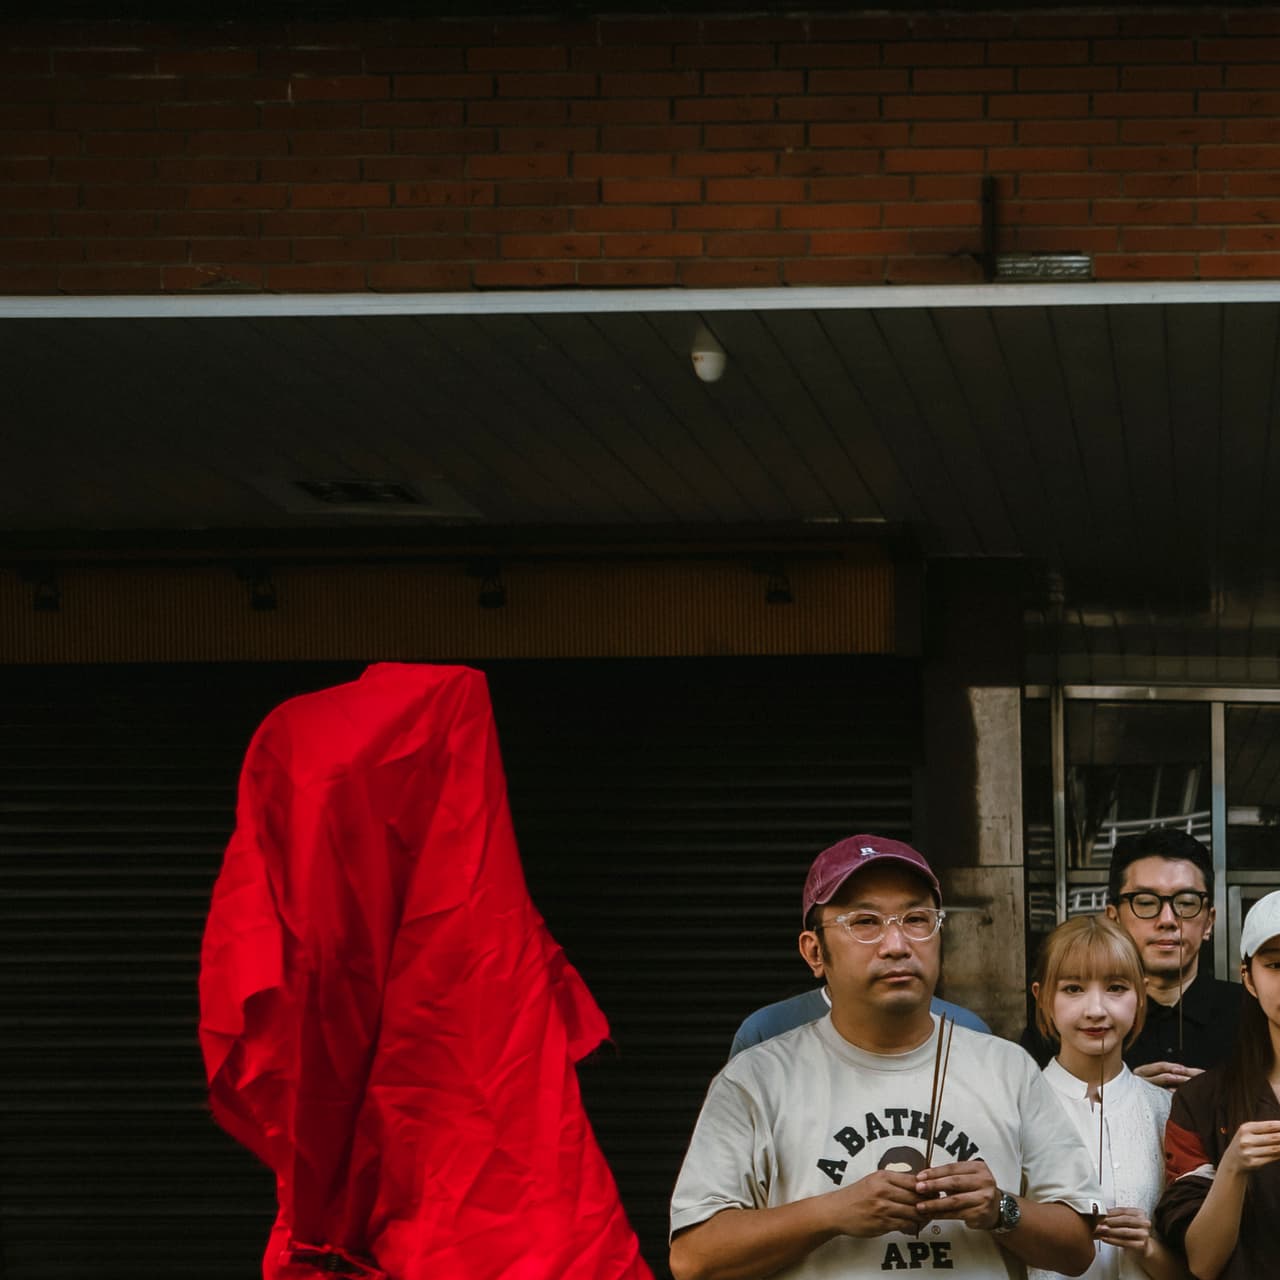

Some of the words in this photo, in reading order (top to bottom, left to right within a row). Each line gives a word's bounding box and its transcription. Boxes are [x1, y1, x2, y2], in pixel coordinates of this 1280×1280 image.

[816, 1157, 848, 1186] A
[833, 1108, 985, 1162] BATHIN
[881, 1242, 954, 1271] APE
